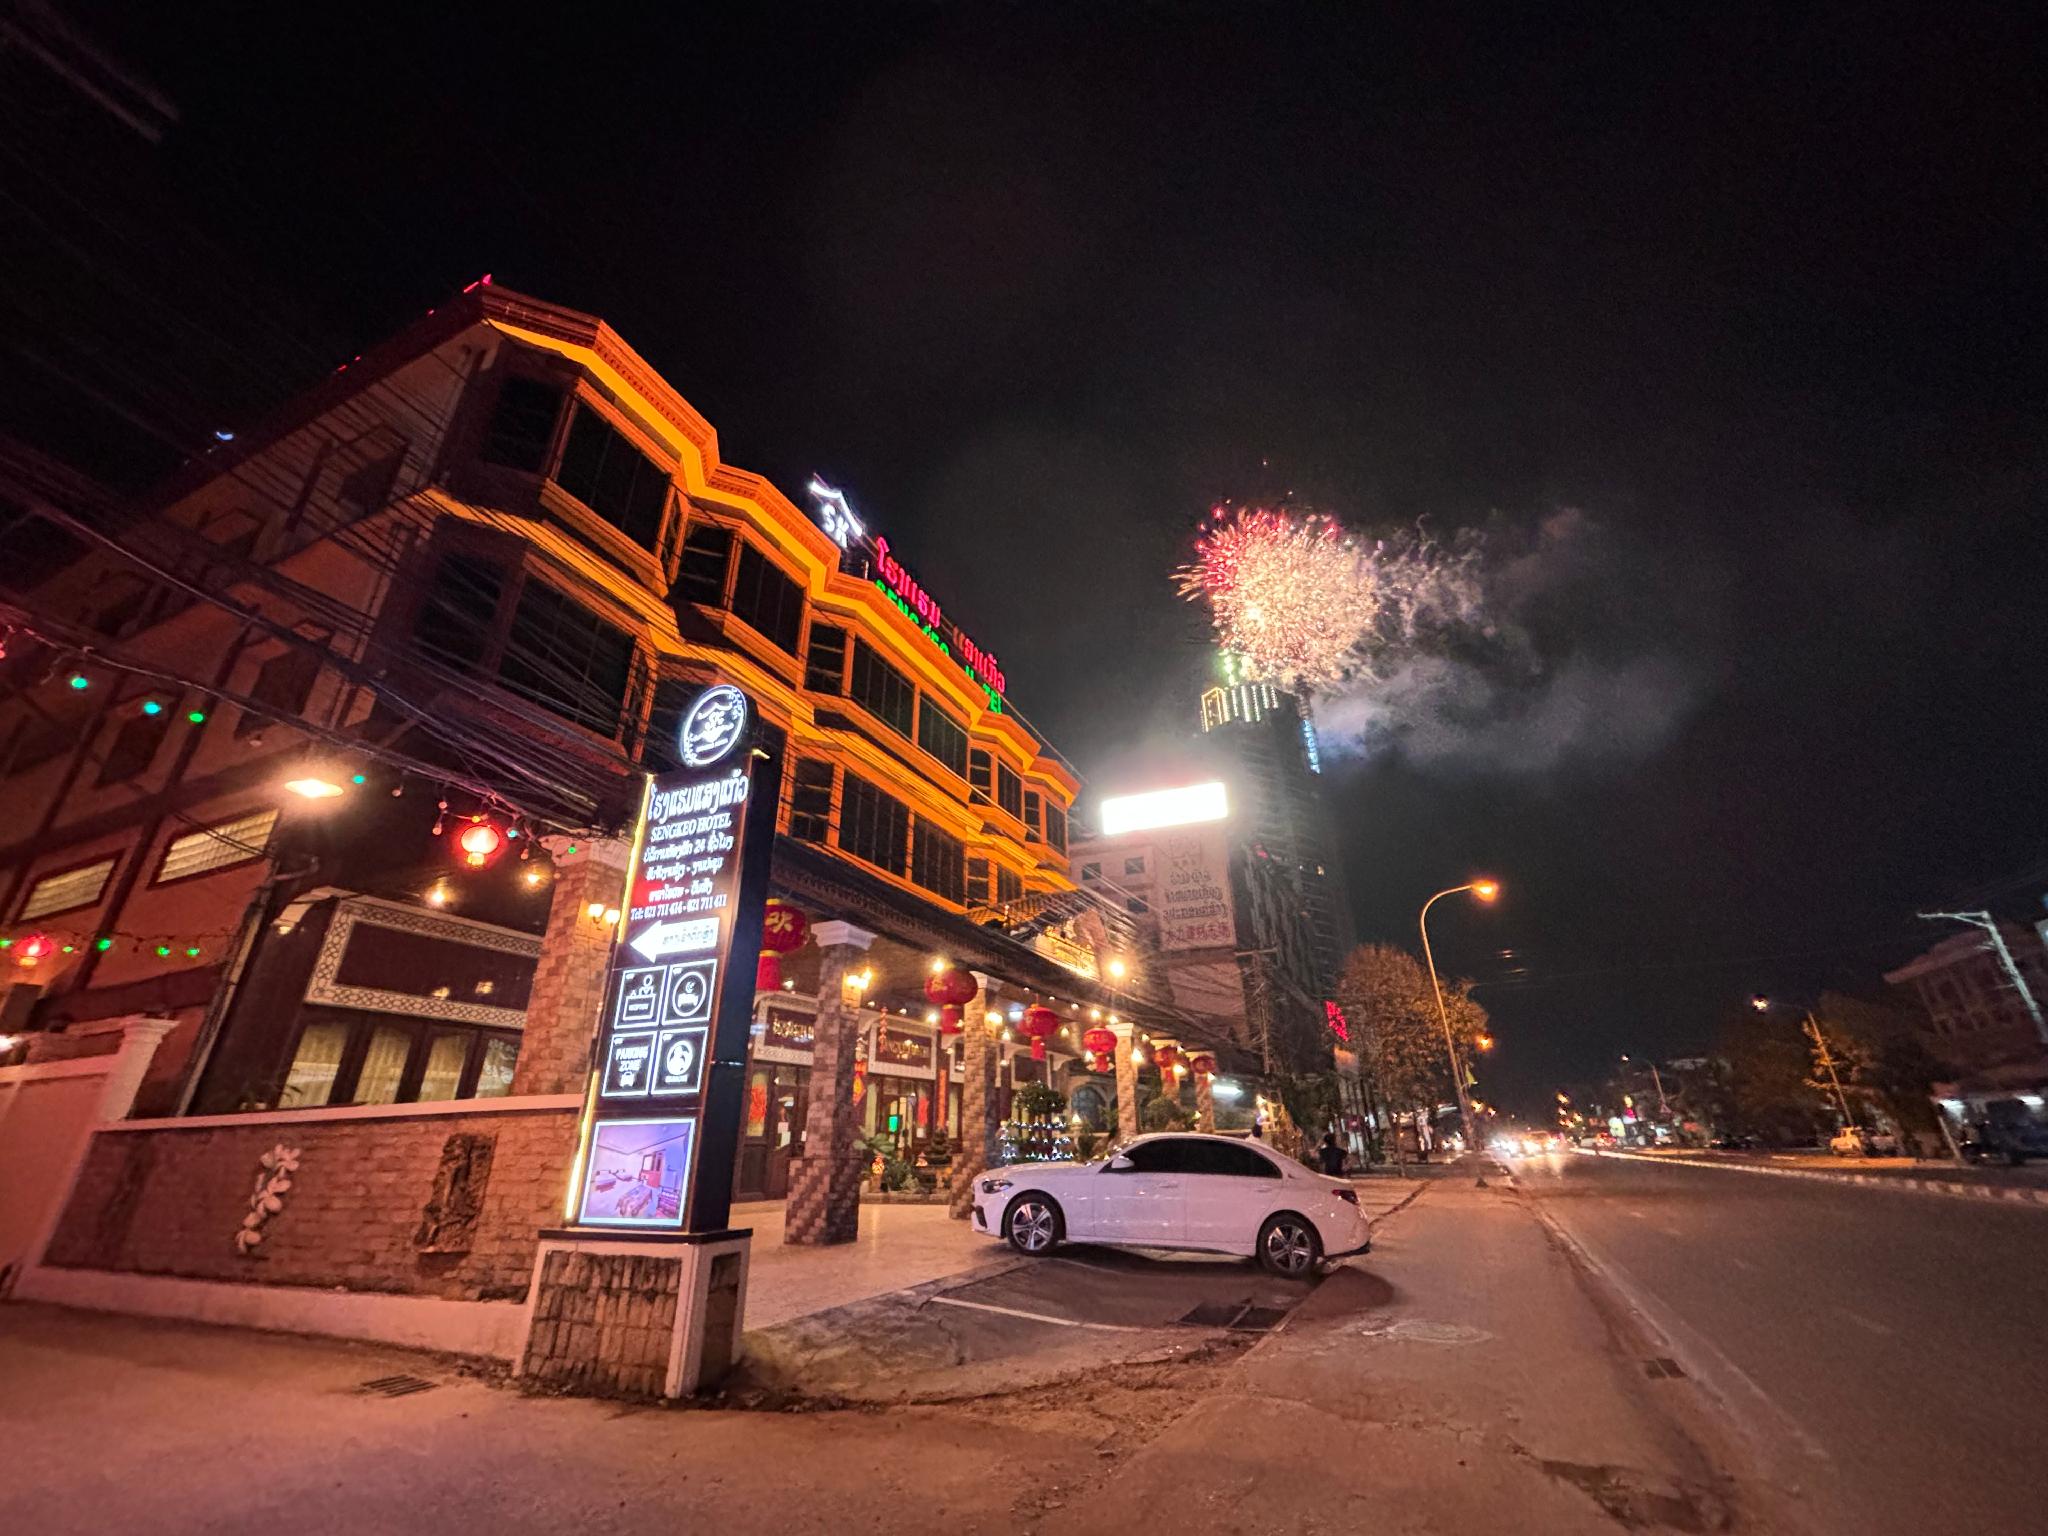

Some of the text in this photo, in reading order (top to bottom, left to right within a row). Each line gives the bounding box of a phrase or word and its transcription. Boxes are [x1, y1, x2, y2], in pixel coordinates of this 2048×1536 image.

[822, 503, 850, 547] SK
[650, 812, 733, 842] SENGKEO HOTEL
[694, 838, 706, 854] 24
